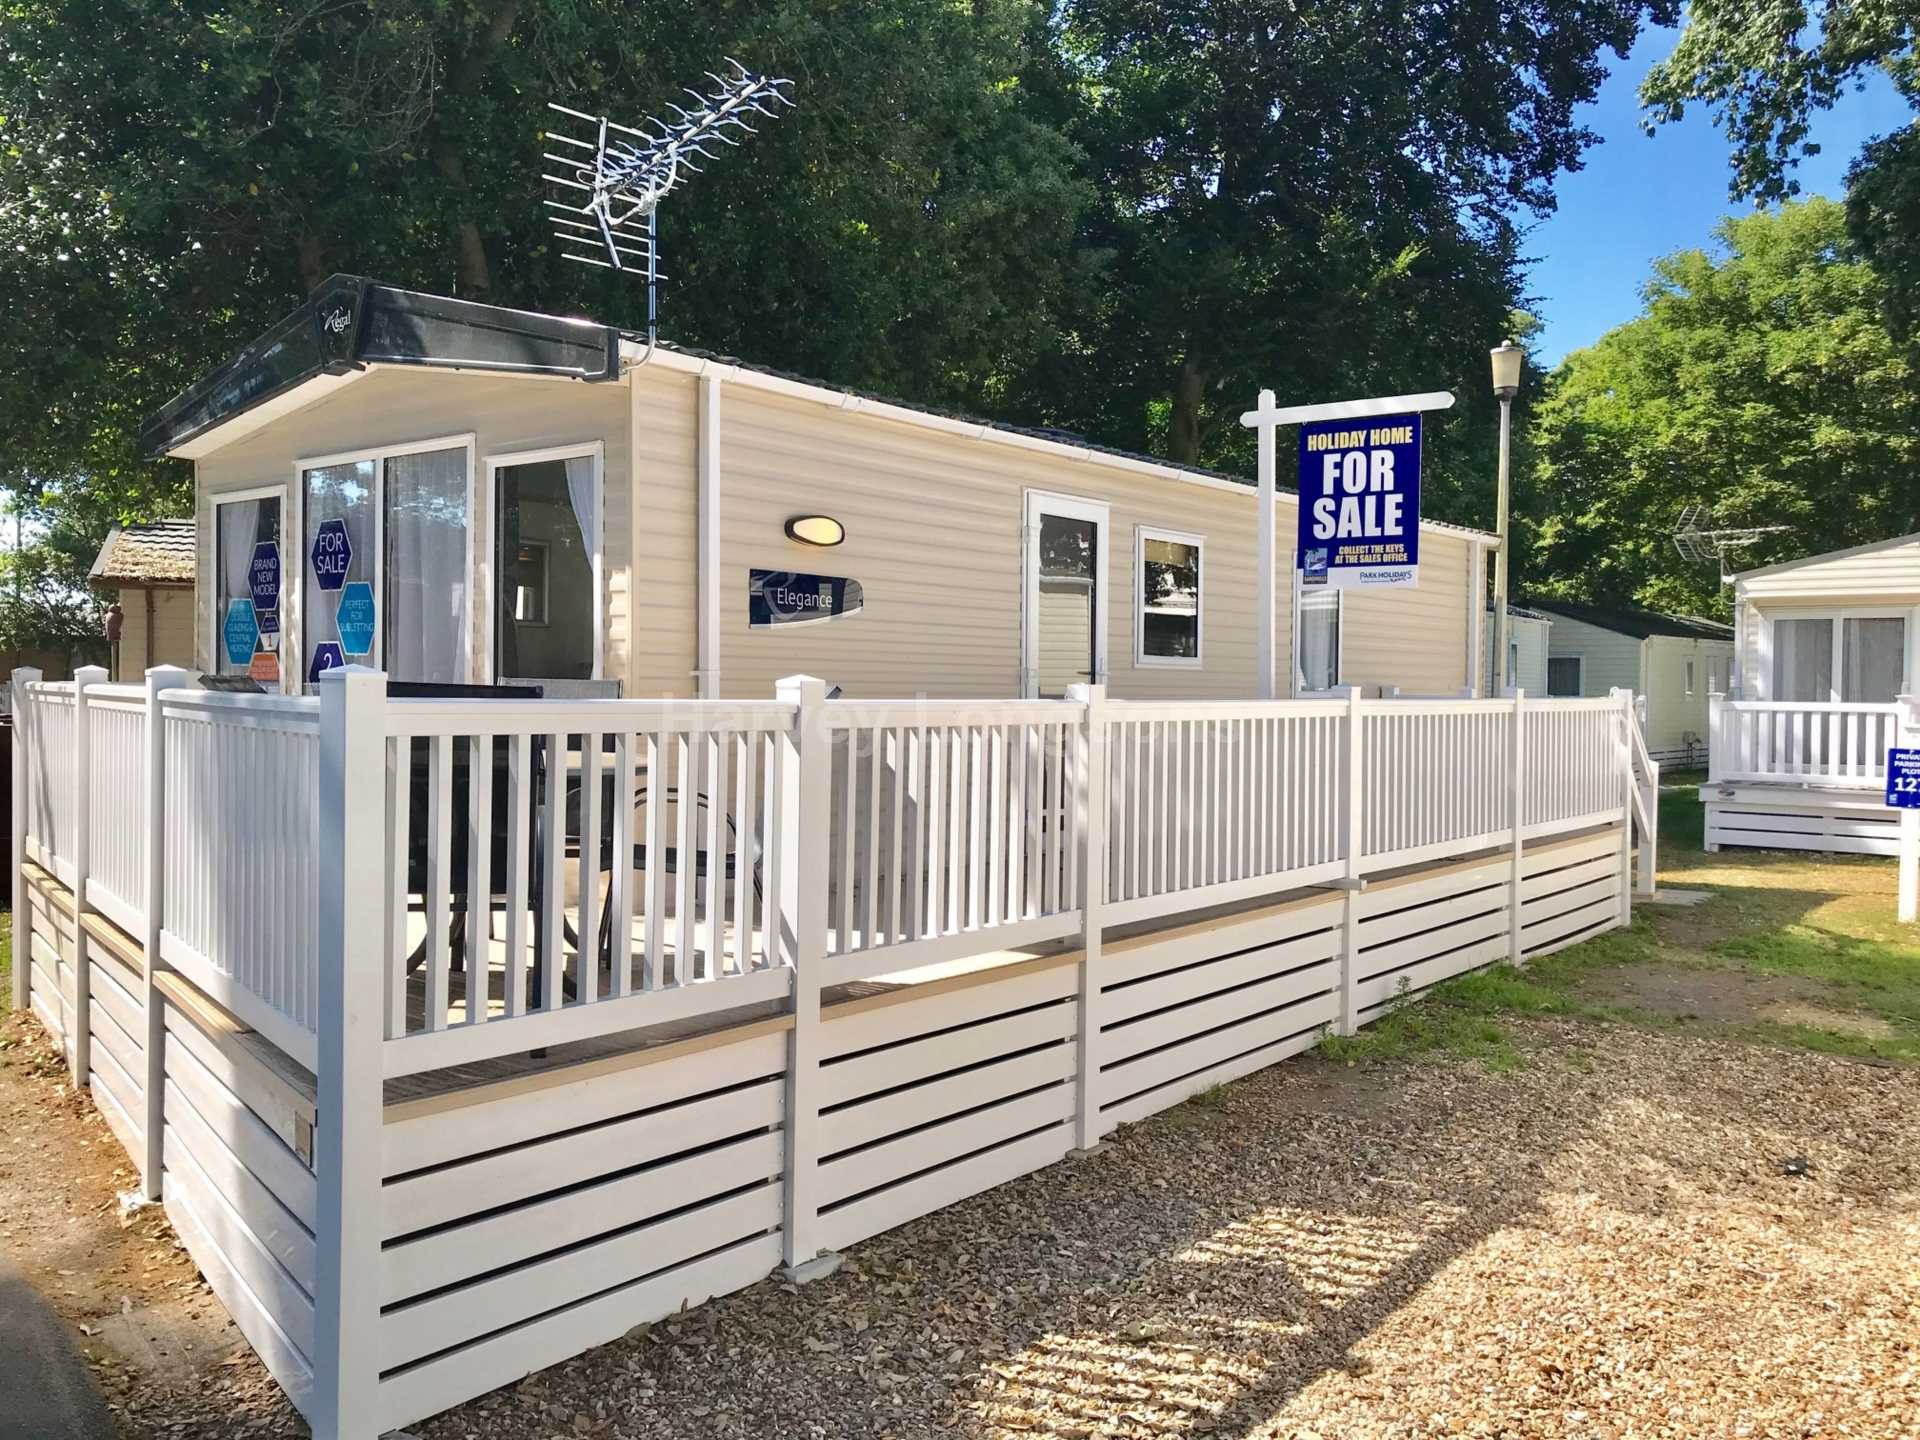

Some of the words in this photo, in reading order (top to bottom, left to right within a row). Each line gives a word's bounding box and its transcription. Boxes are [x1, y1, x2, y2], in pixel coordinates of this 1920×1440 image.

[322, 307, 351, 334] Regal
[1307, 430, 1367, 451] HOLIDAY
[1370, 426, 1413, 446] HOME
[1322, 449, 1395, 495] FOR
[1312, 493, 1404, 540] SALE
[319, 532, 344, 553] FOR
[1338, 545, 1369, 555] COLLECT
[1370, 544, 1384, 554] THE
[1385, 543, 1405, 553] KEYS
[254, 557, 277, 570] BRAND
[317, 553, 345, 574] SALE
[1334, 555, 1344, 564] AT
[1345, 554, 1358, 564] THE
[1359, 553, 1382, 563] SALES
[1383, 552, 1408, 563] OFFICE
[257, 571, 273, 583] NEW
[1359, 571, 1377, 579] PARK
[1378, 569, 1413, 579] HOLIDAYS
[253, 583, 277, 596] MODEL
[777, 587, 833, 610] Elegance
